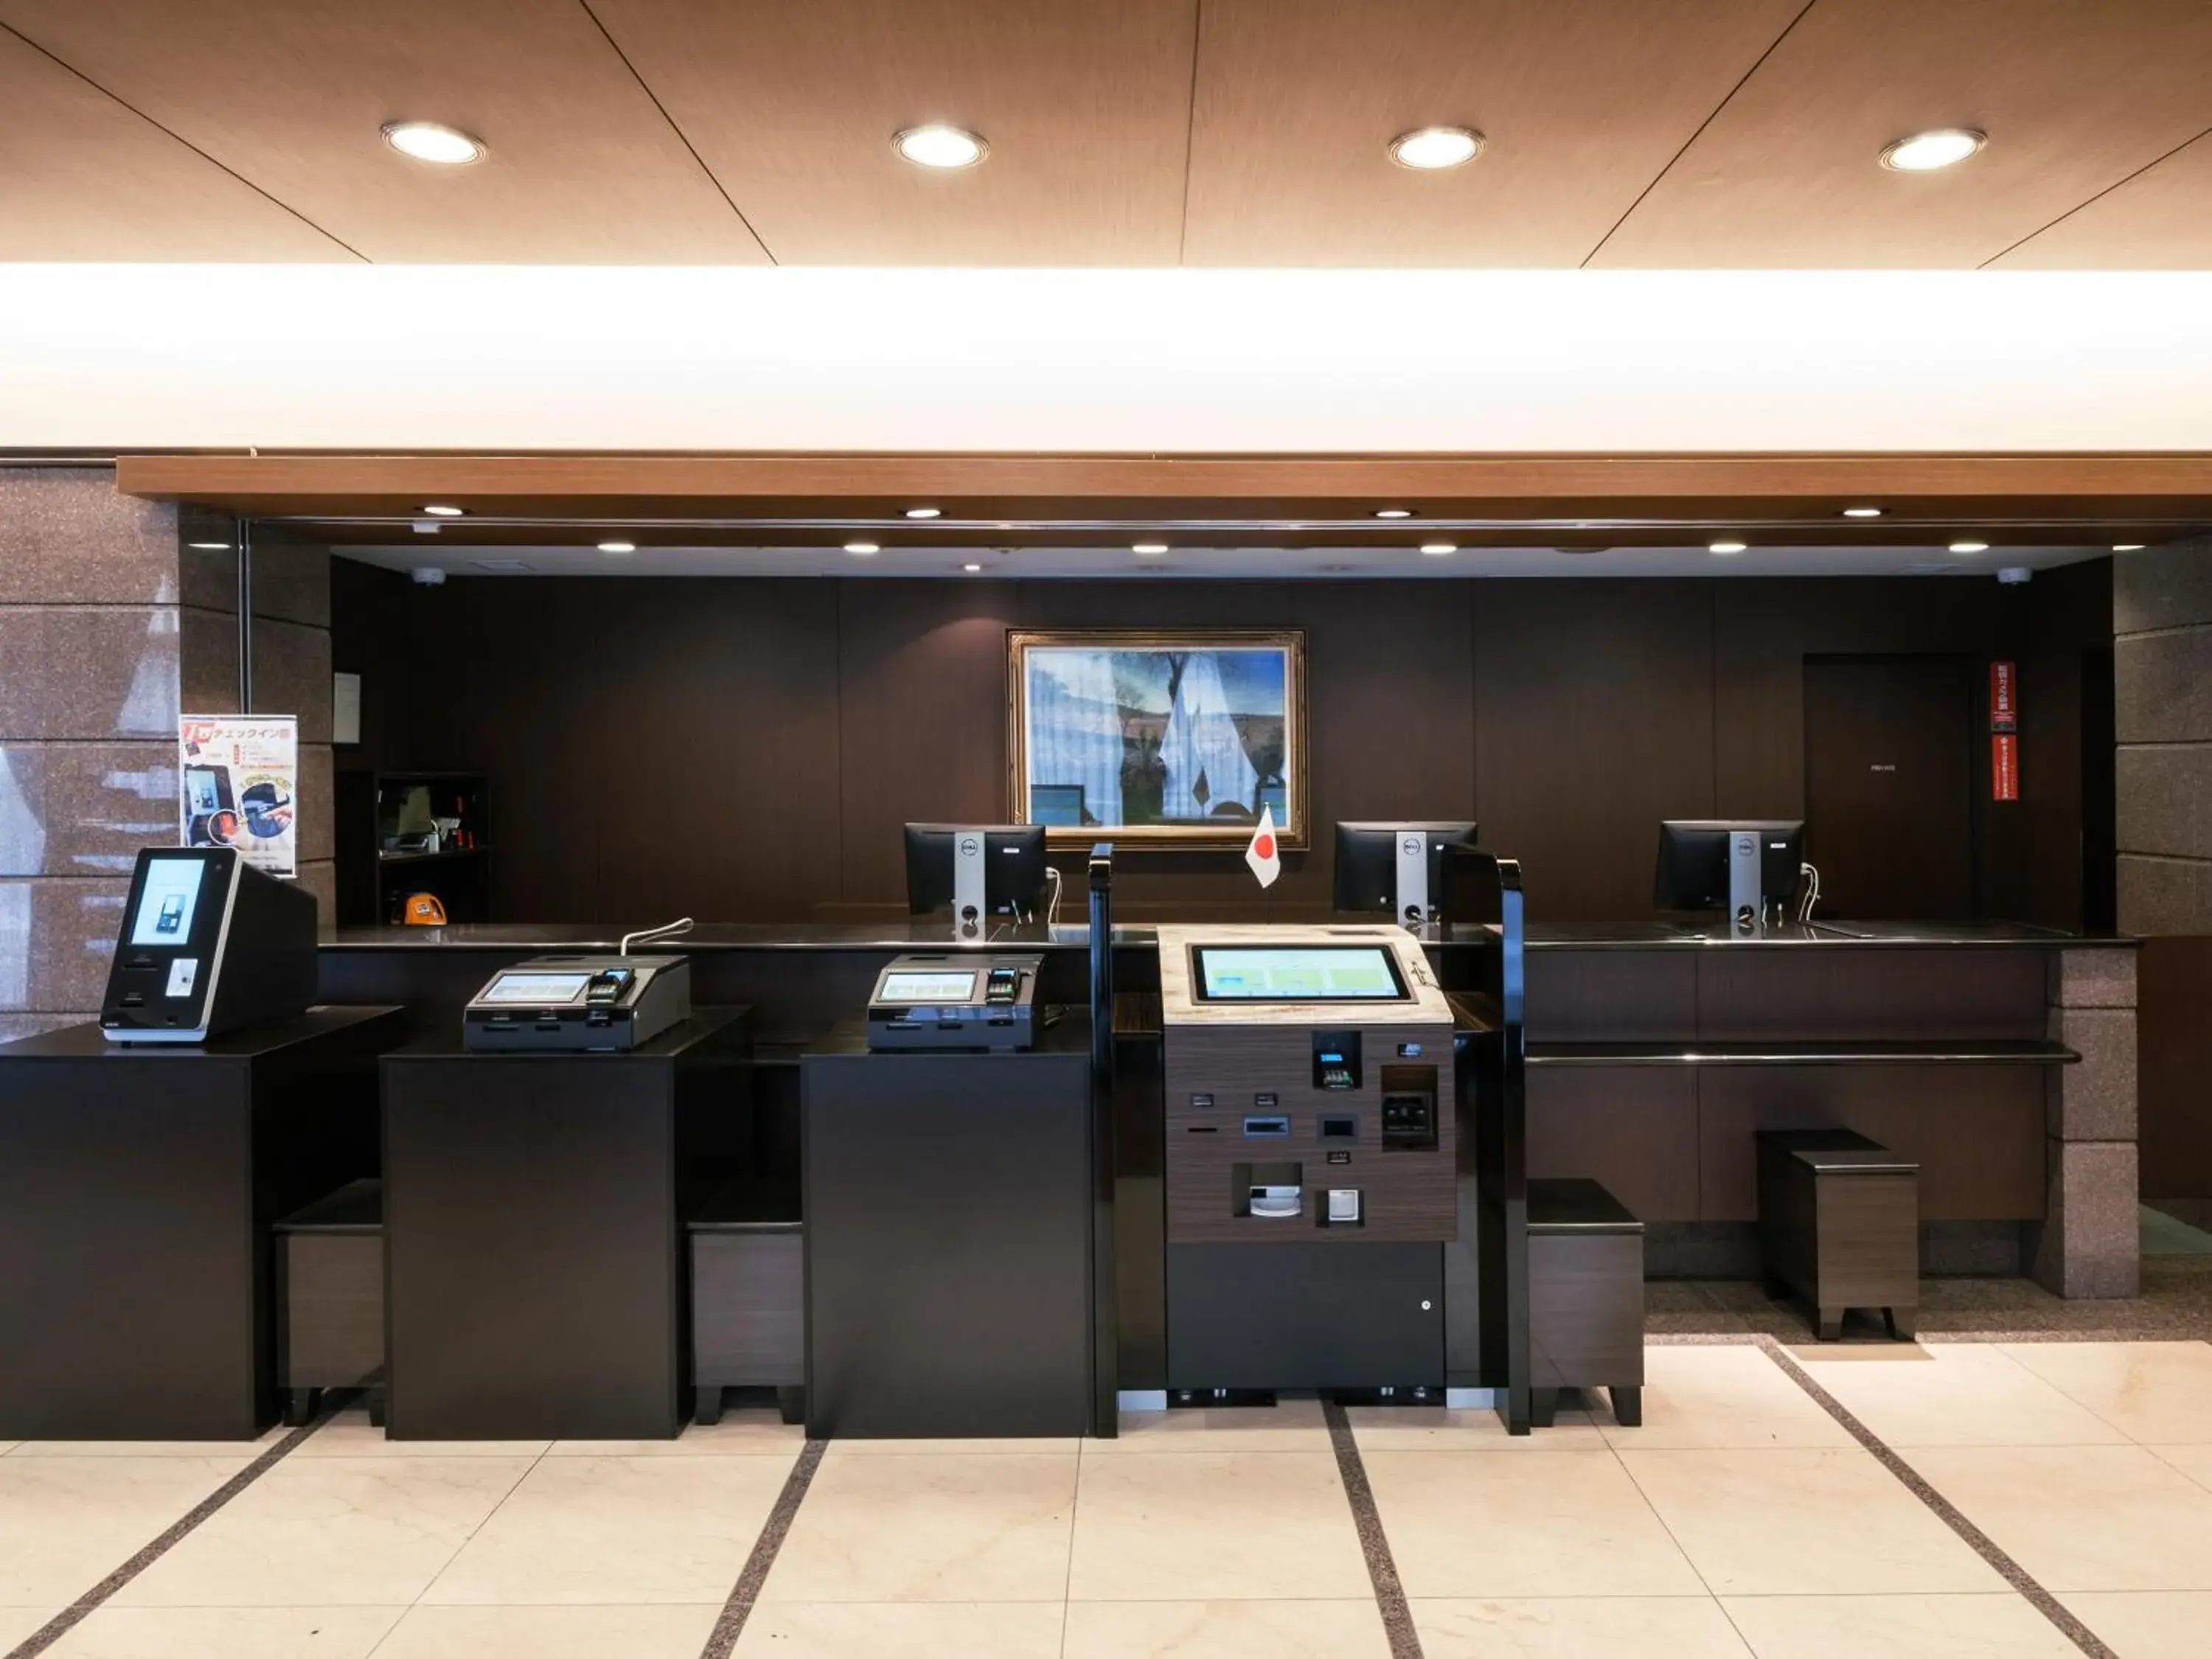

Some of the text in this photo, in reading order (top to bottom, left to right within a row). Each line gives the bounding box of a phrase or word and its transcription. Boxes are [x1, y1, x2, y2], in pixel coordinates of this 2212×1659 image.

[214, 728, 290, 739] チェックイン
